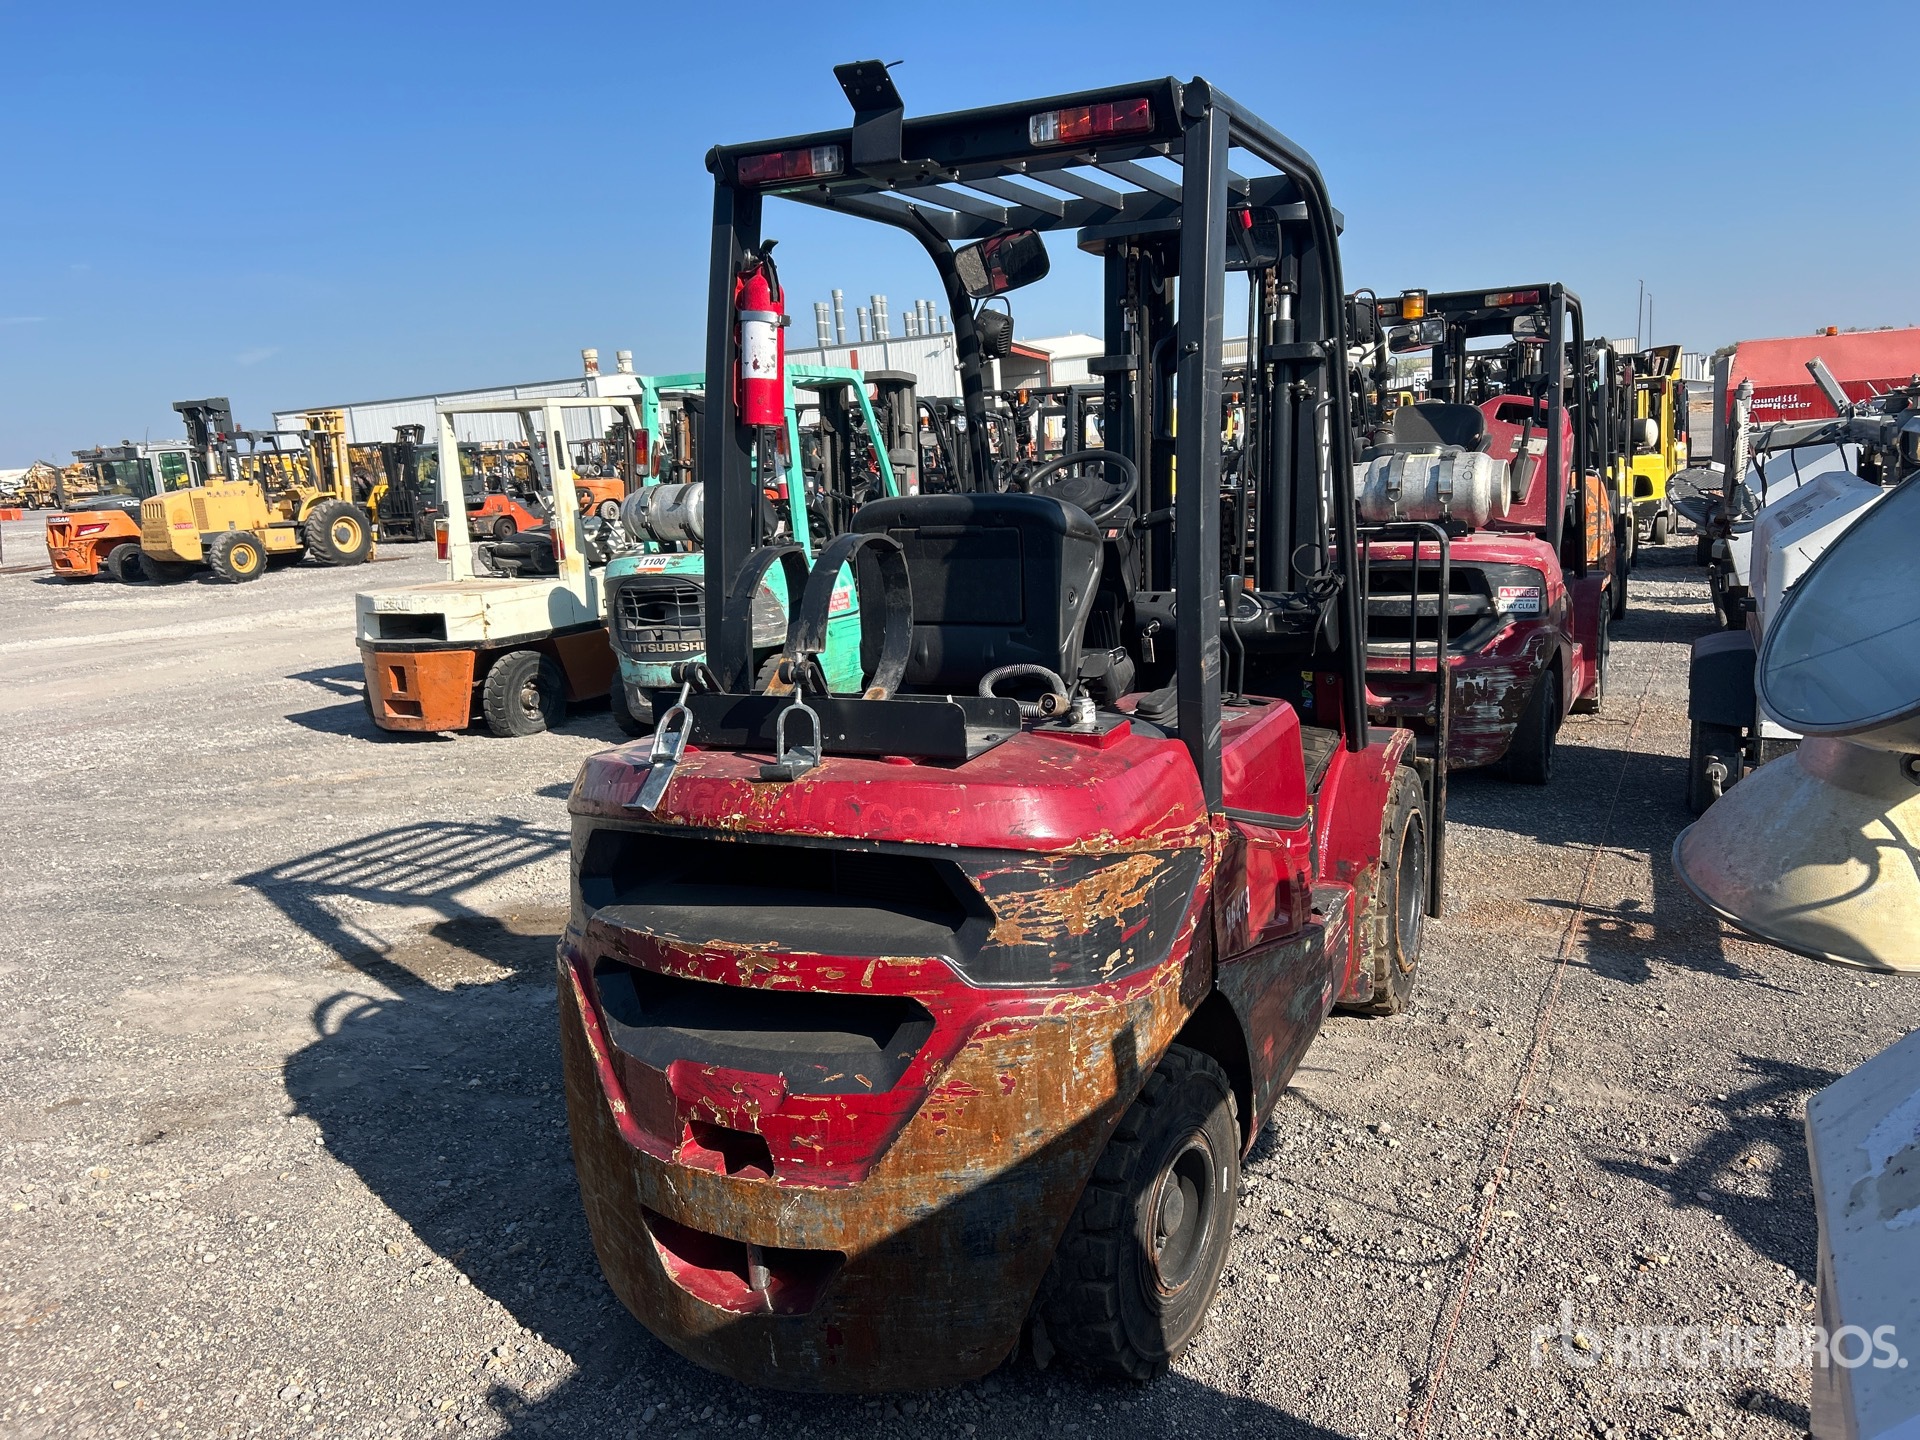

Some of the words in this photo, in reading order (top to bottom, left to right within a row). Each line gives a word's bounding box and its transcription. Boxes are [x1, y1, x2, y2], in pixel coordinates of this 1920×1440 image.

[1773, 402, 1811, 410] Heater
[643, 557, 667, 566] 1100
[1509, 588, 1539, 597] DANGER
[631, 641, 705, 653] MITSUBISHI
